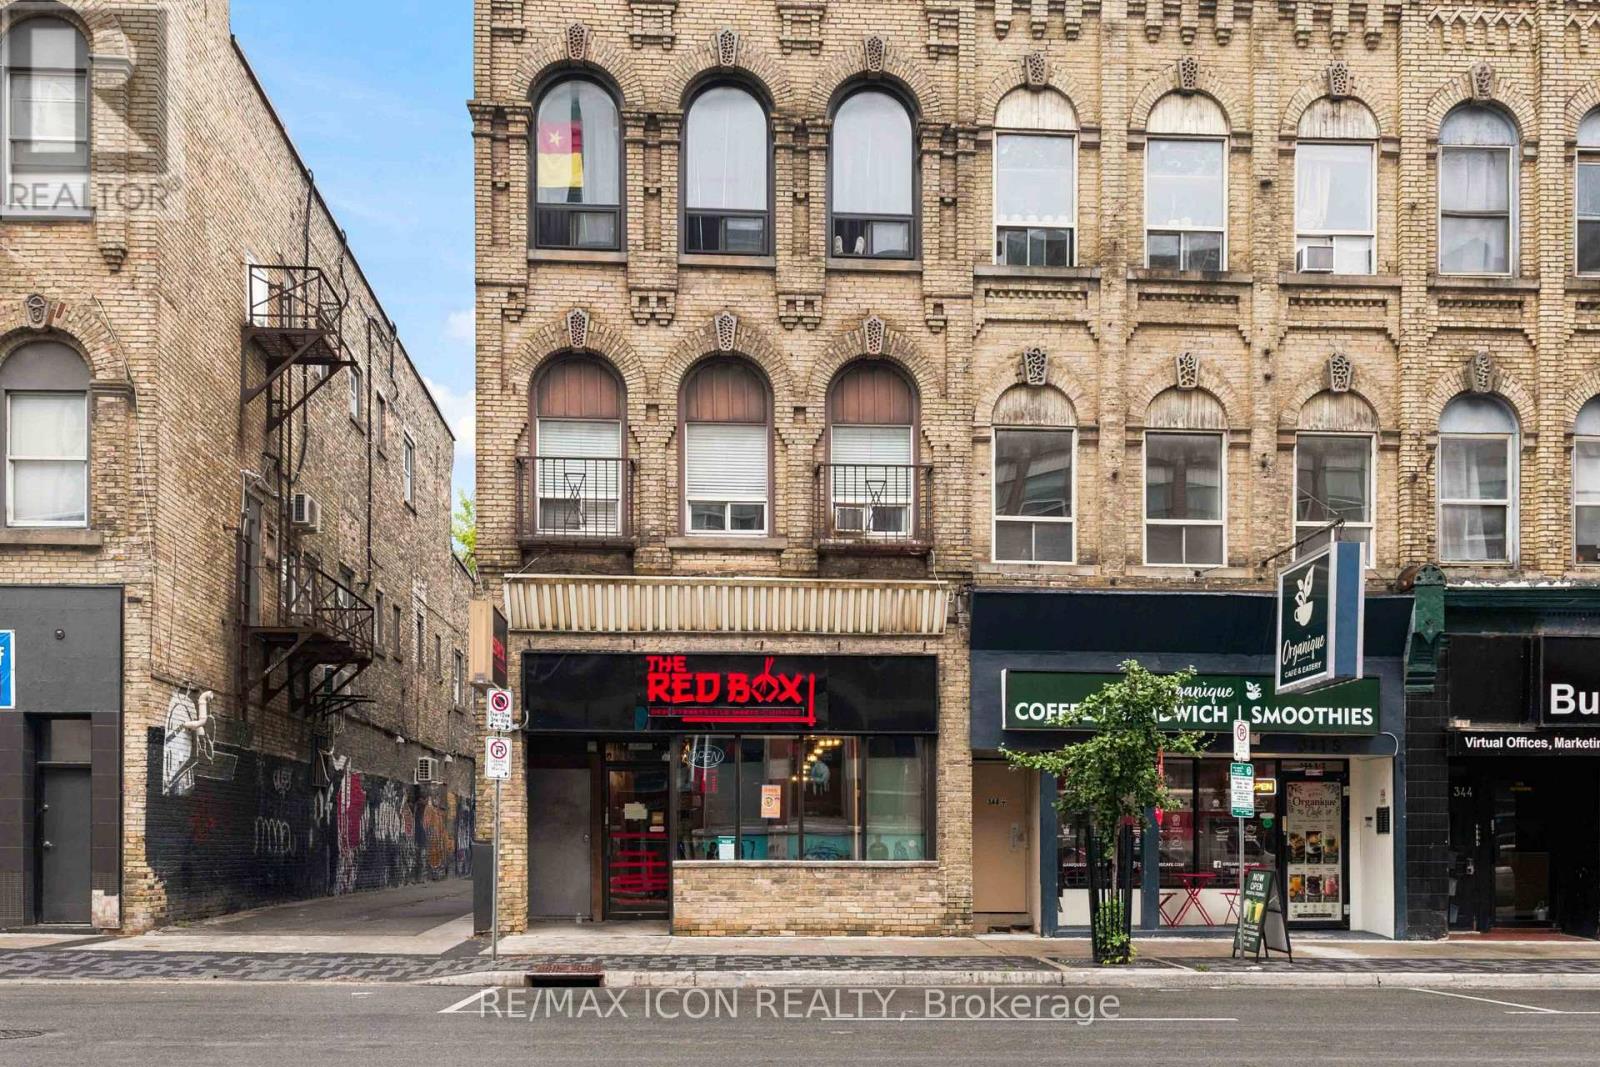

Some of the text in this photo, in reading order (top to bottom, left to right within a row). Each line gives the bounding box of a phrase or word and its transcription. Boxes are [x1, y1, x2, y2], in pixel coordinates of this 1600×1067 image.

[1282, 635, 1325, 666] Organique
[646, 656, 687, 672] THE
[1302, 661, 1322, 674] EATERY
[647, 657, 803, 704] RED BOX
[1171, 681, 1235, 705] ganique
[1550, 683, 1600, 715] Bu
[1014, 702, 1094, 722] COFFE
[1251, 706, 1374, 726] SMOOTHIES
[1465, 736, 1503, 748] Virtual
[1506, 737, 1553, 750] Offices,
[692, 750, 721, 763] OPEN
[1453, 786, 1473, 798] 344
[1292, 796, 1337, 808] Organique
[1252, 872, 1265, 882] NOW
[1249, 882, 1264, 892] OPEN
